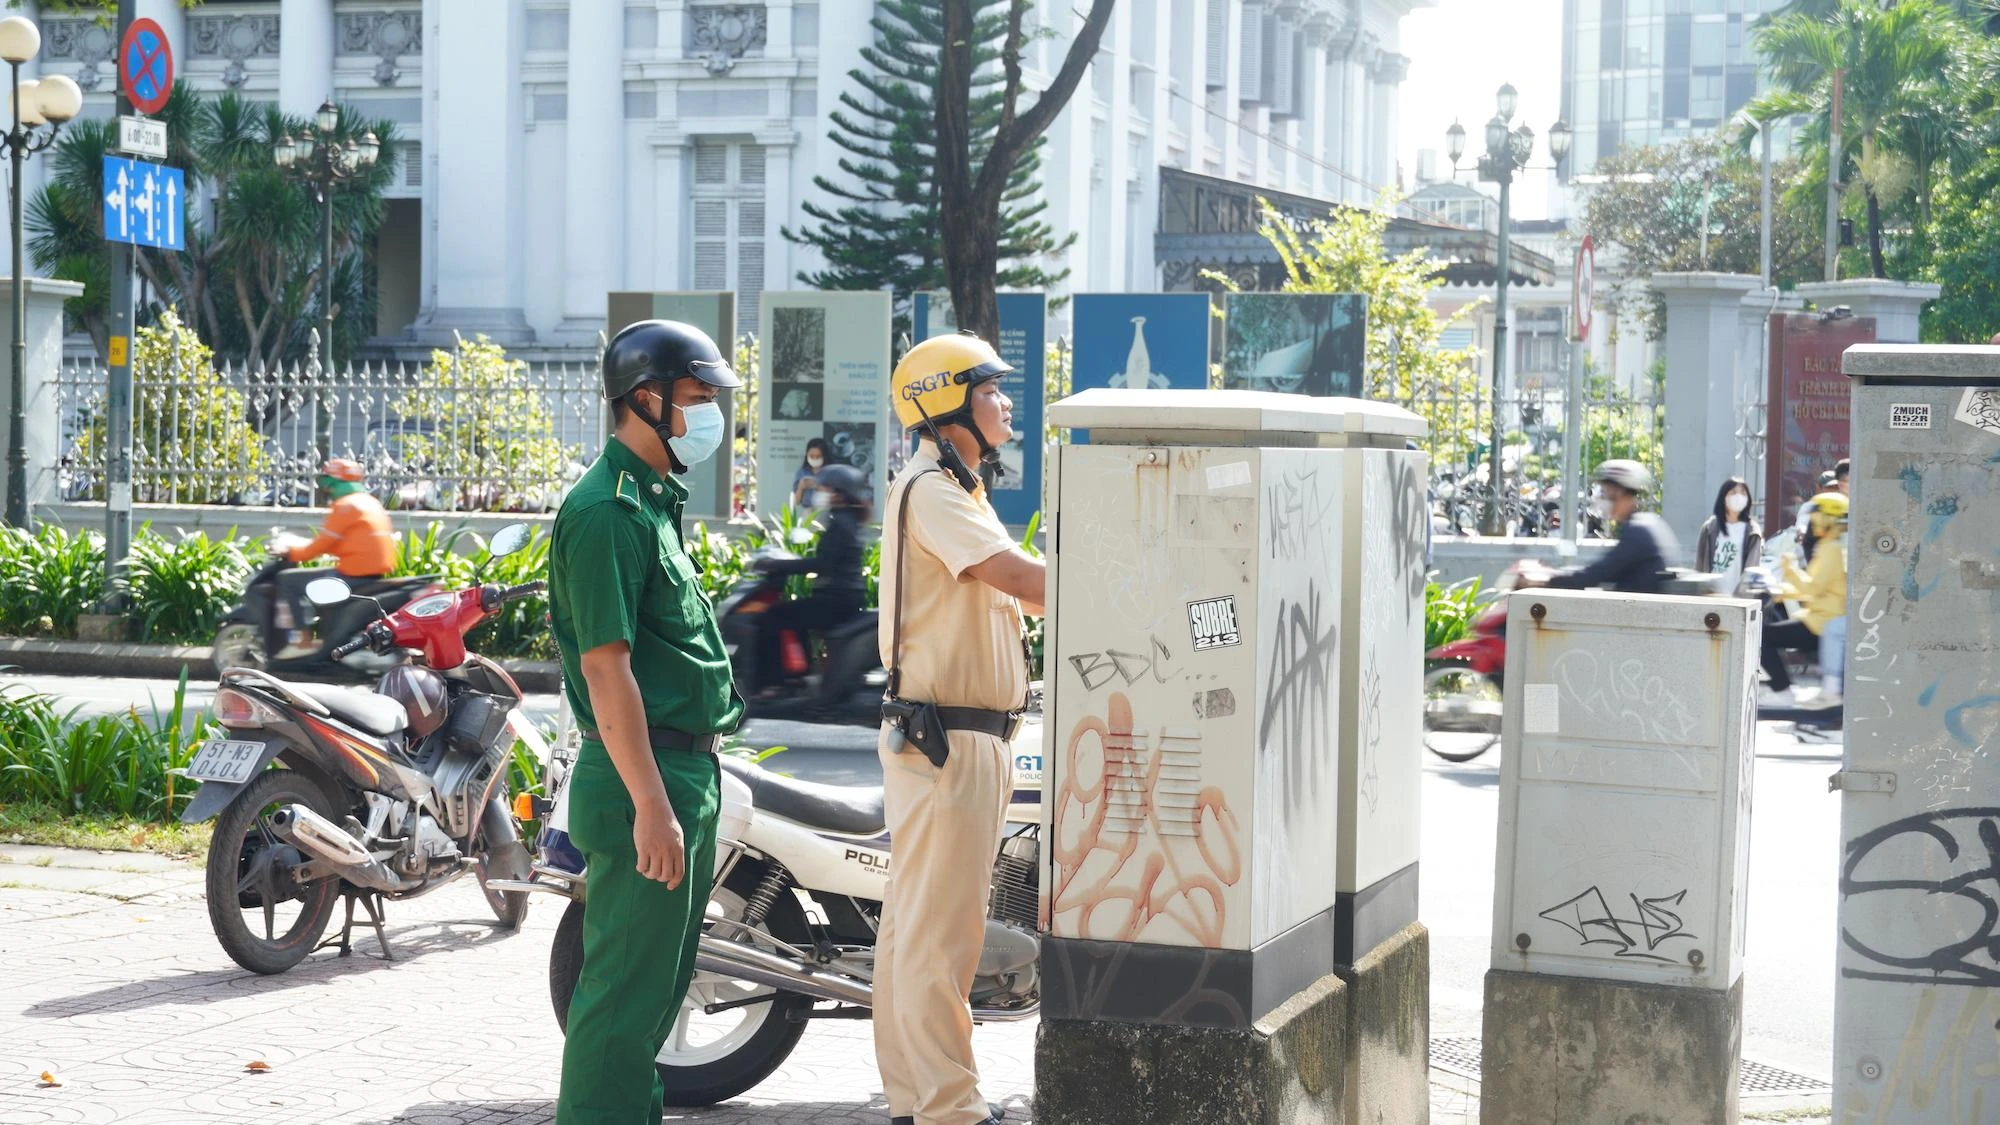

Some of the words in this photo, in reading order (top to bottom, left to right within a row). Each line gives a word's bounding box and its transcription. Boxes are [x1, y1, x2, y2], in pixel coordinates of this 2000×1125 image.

[902, 371, 951, 401] CSGT
[1893, 406, 1928, 415] 2MUCH
[1191, 599, 1237, 638] SUBRE
[1195, 633, 1239, 649] 213
[196, 759, 242, 778] 0404
[845, 849, 890, 870] POLI
